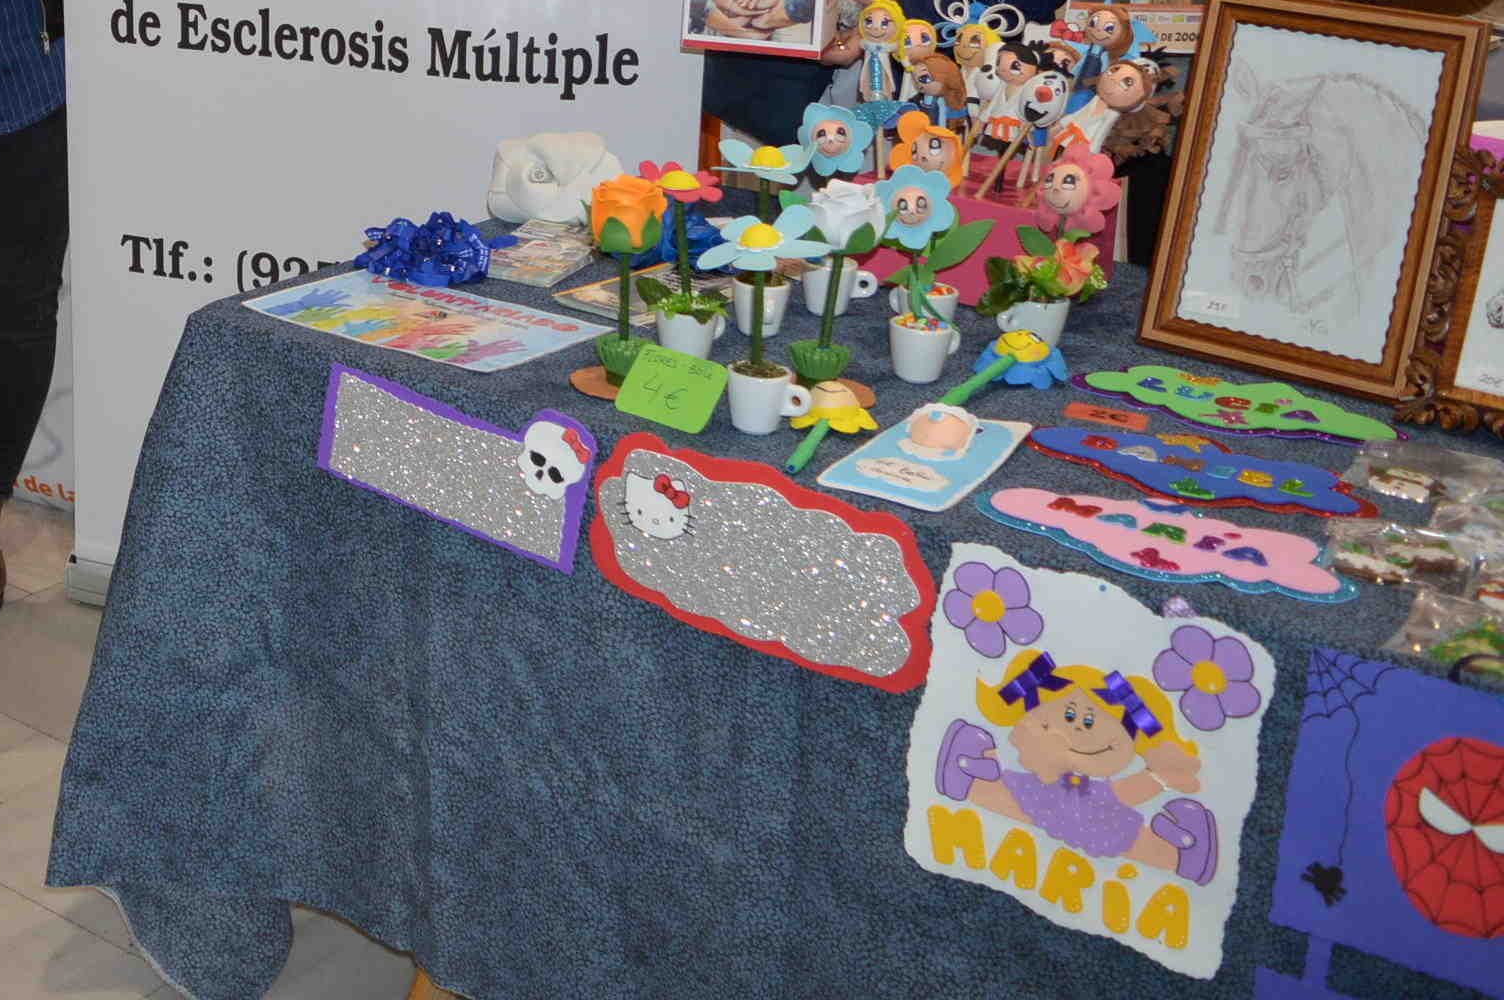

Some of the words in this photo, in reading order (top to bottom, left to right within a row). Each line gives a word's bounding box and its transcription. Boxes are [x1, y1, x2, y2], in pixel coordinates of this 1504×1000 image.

[177, 2, 409, 73] Esclerosis
[427, 27, 640, 100] Múltiple
[121, 235, 214, 284] Tlf.:
[24, 475, 52, 497] de
